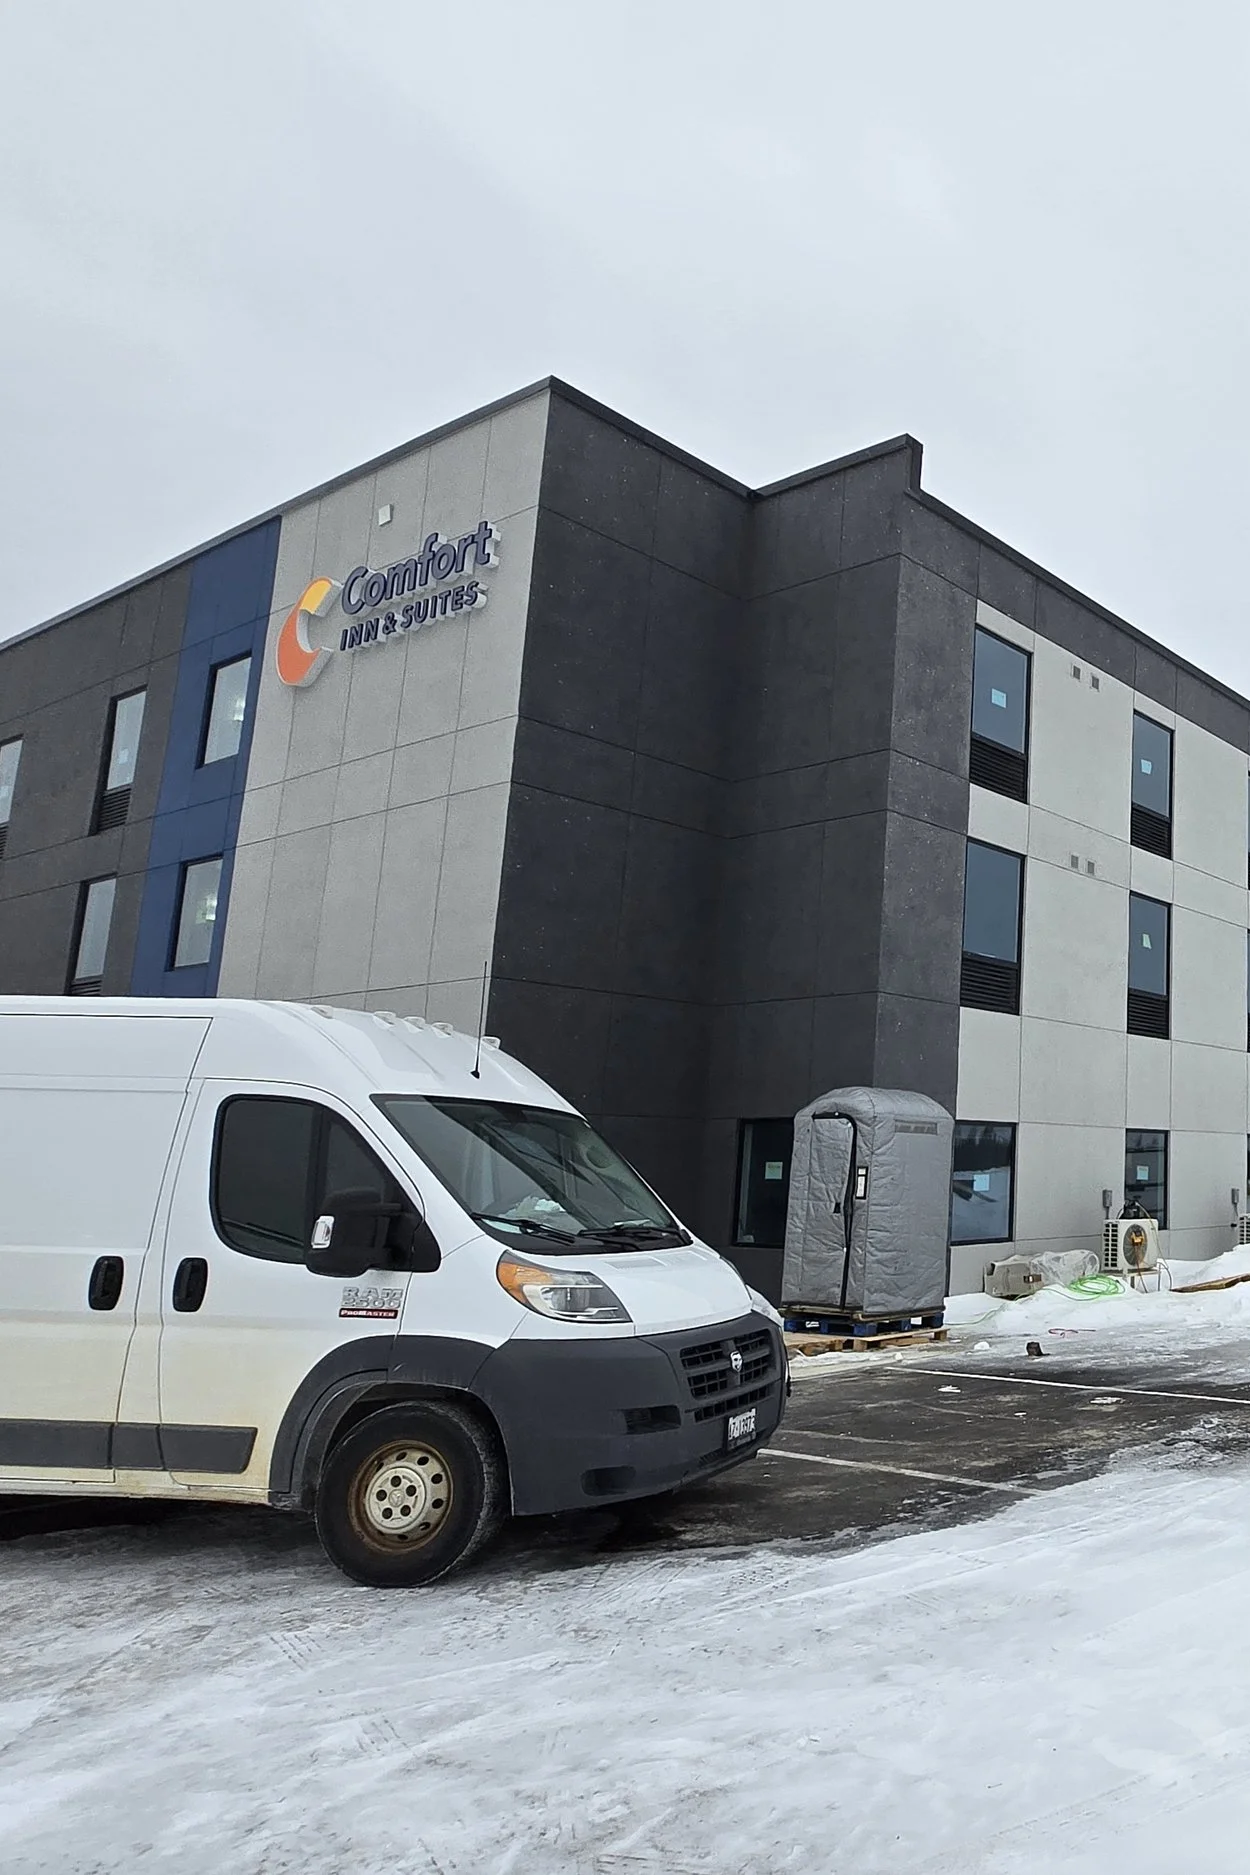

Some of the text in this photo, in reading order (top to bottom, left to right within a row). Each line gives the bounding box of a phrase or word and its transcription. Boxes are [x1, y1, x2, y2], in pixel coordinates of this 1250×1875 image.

[341, 520, 493, 616] Comfort
[339, 580, 480, 651] INN & SUITES
[342, 1286, 404, 1298] RAM
